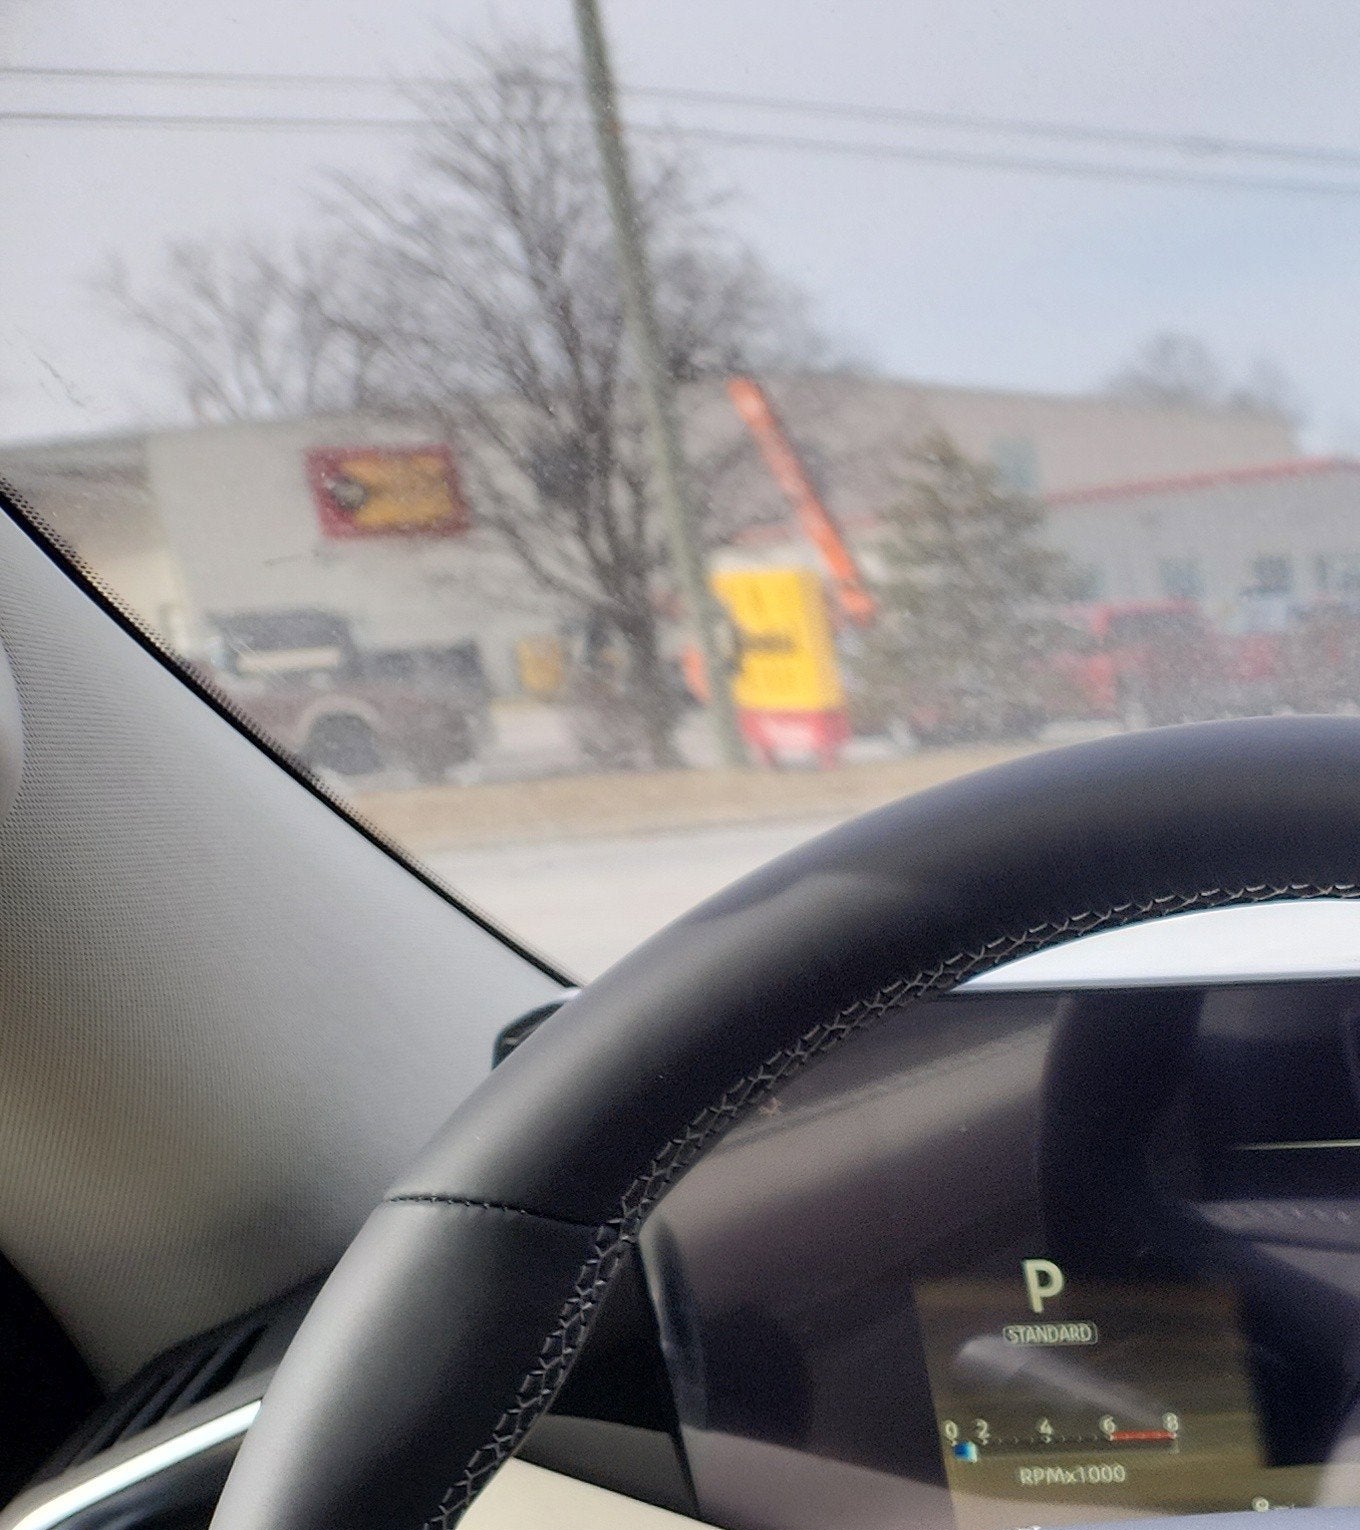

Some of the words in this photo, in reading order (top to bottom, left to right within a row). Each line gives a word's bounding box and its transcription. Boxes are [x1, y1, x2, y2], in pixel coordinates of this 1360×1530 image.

[1021, 1258, 1065, 1314] P
[1007, 1323, 1093, 1344] STANDARD
[945, 1421, 958, 1440] 0
[975, 1419, 989, 1439] 2
[1037, 1417, 1054, 1436] 4
[1101, 1414, 1116, 1436] 6
[1162, 1412, 1179, 1433] 8
[1019, 1464, 1126, 1486] RPMx1000
